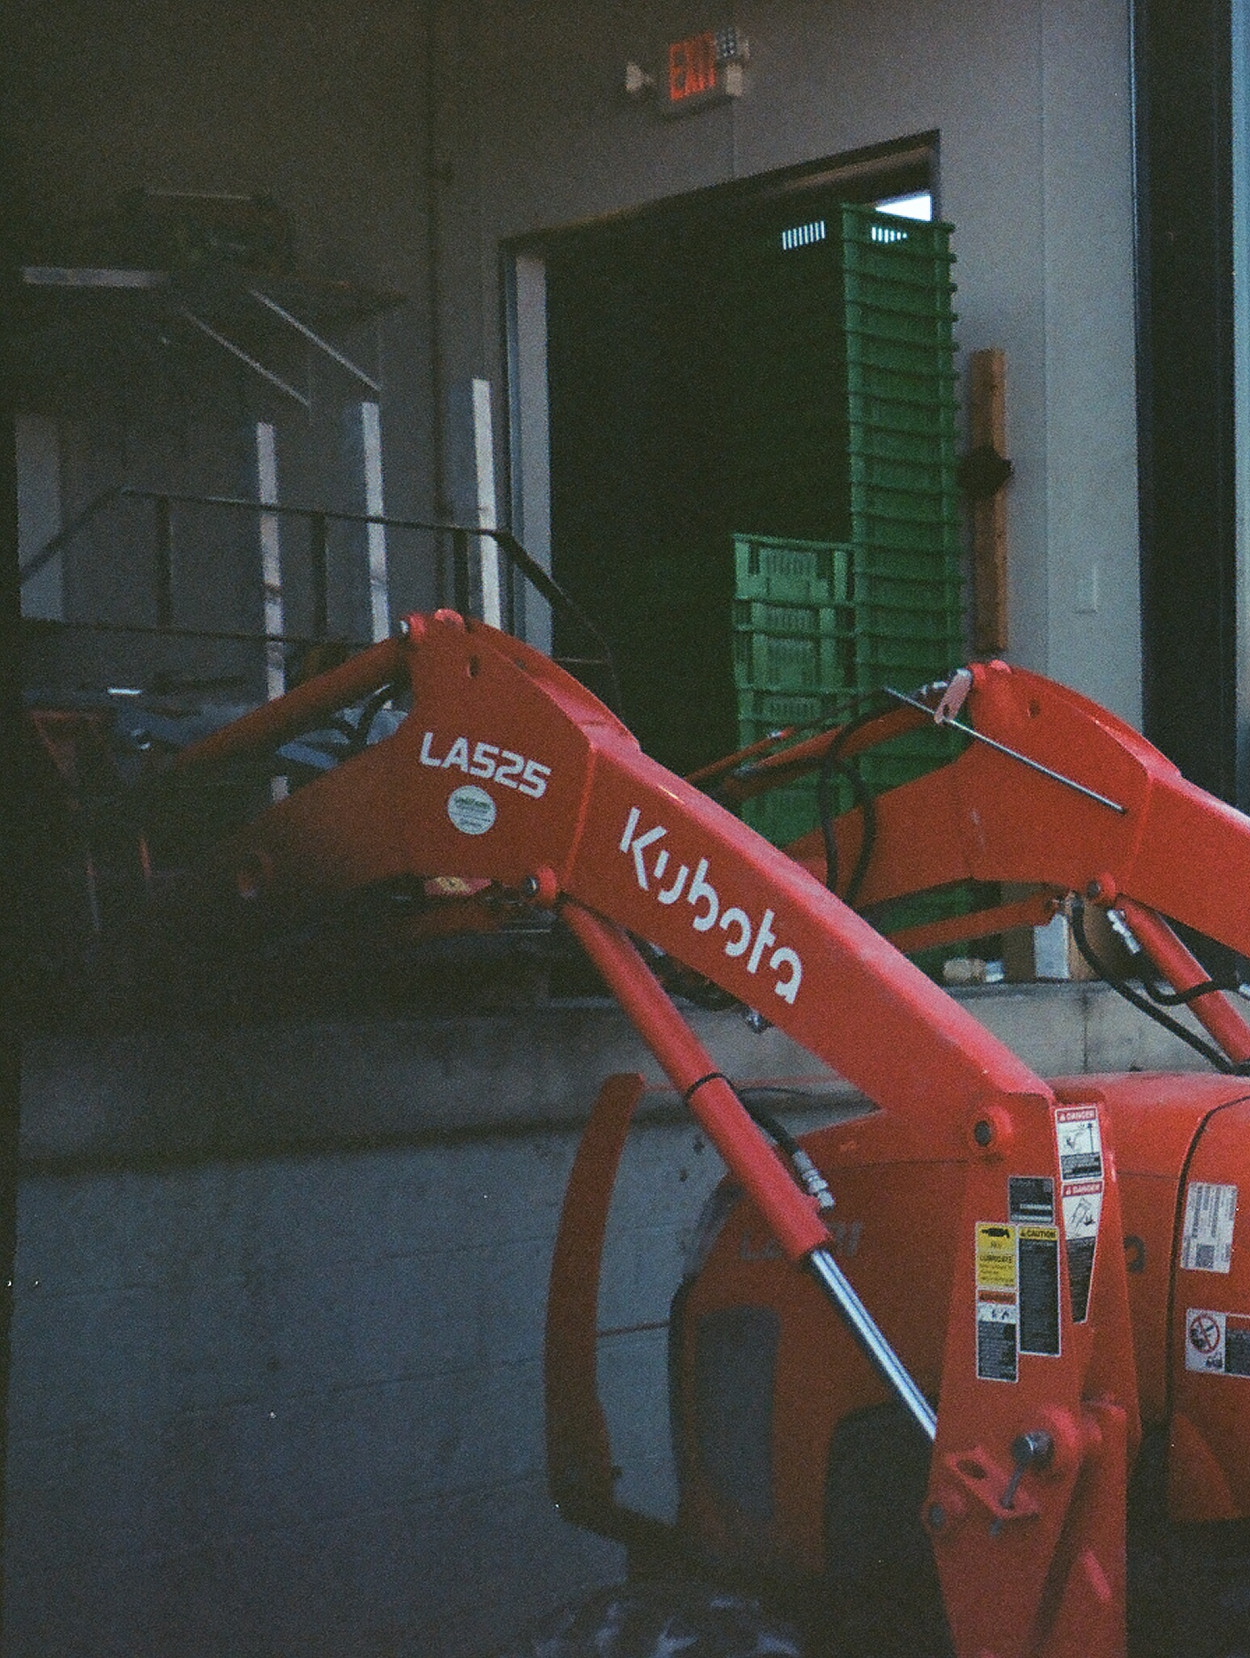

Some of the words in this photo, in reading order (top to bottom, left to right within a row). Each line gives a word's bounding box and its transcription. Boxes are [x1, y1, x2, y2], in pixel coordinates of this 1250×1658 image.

[668, 31, 716, 101] EXIT
[419, 732, 552, 799] LA525
[619, 806, 803, 1005] Kubota
[1066, 1110, 1095, 1120] DANGER
[1072, 1184, 1101, 1194] DANGER
[1027, 1229, 1057, 1238] CAUTION
